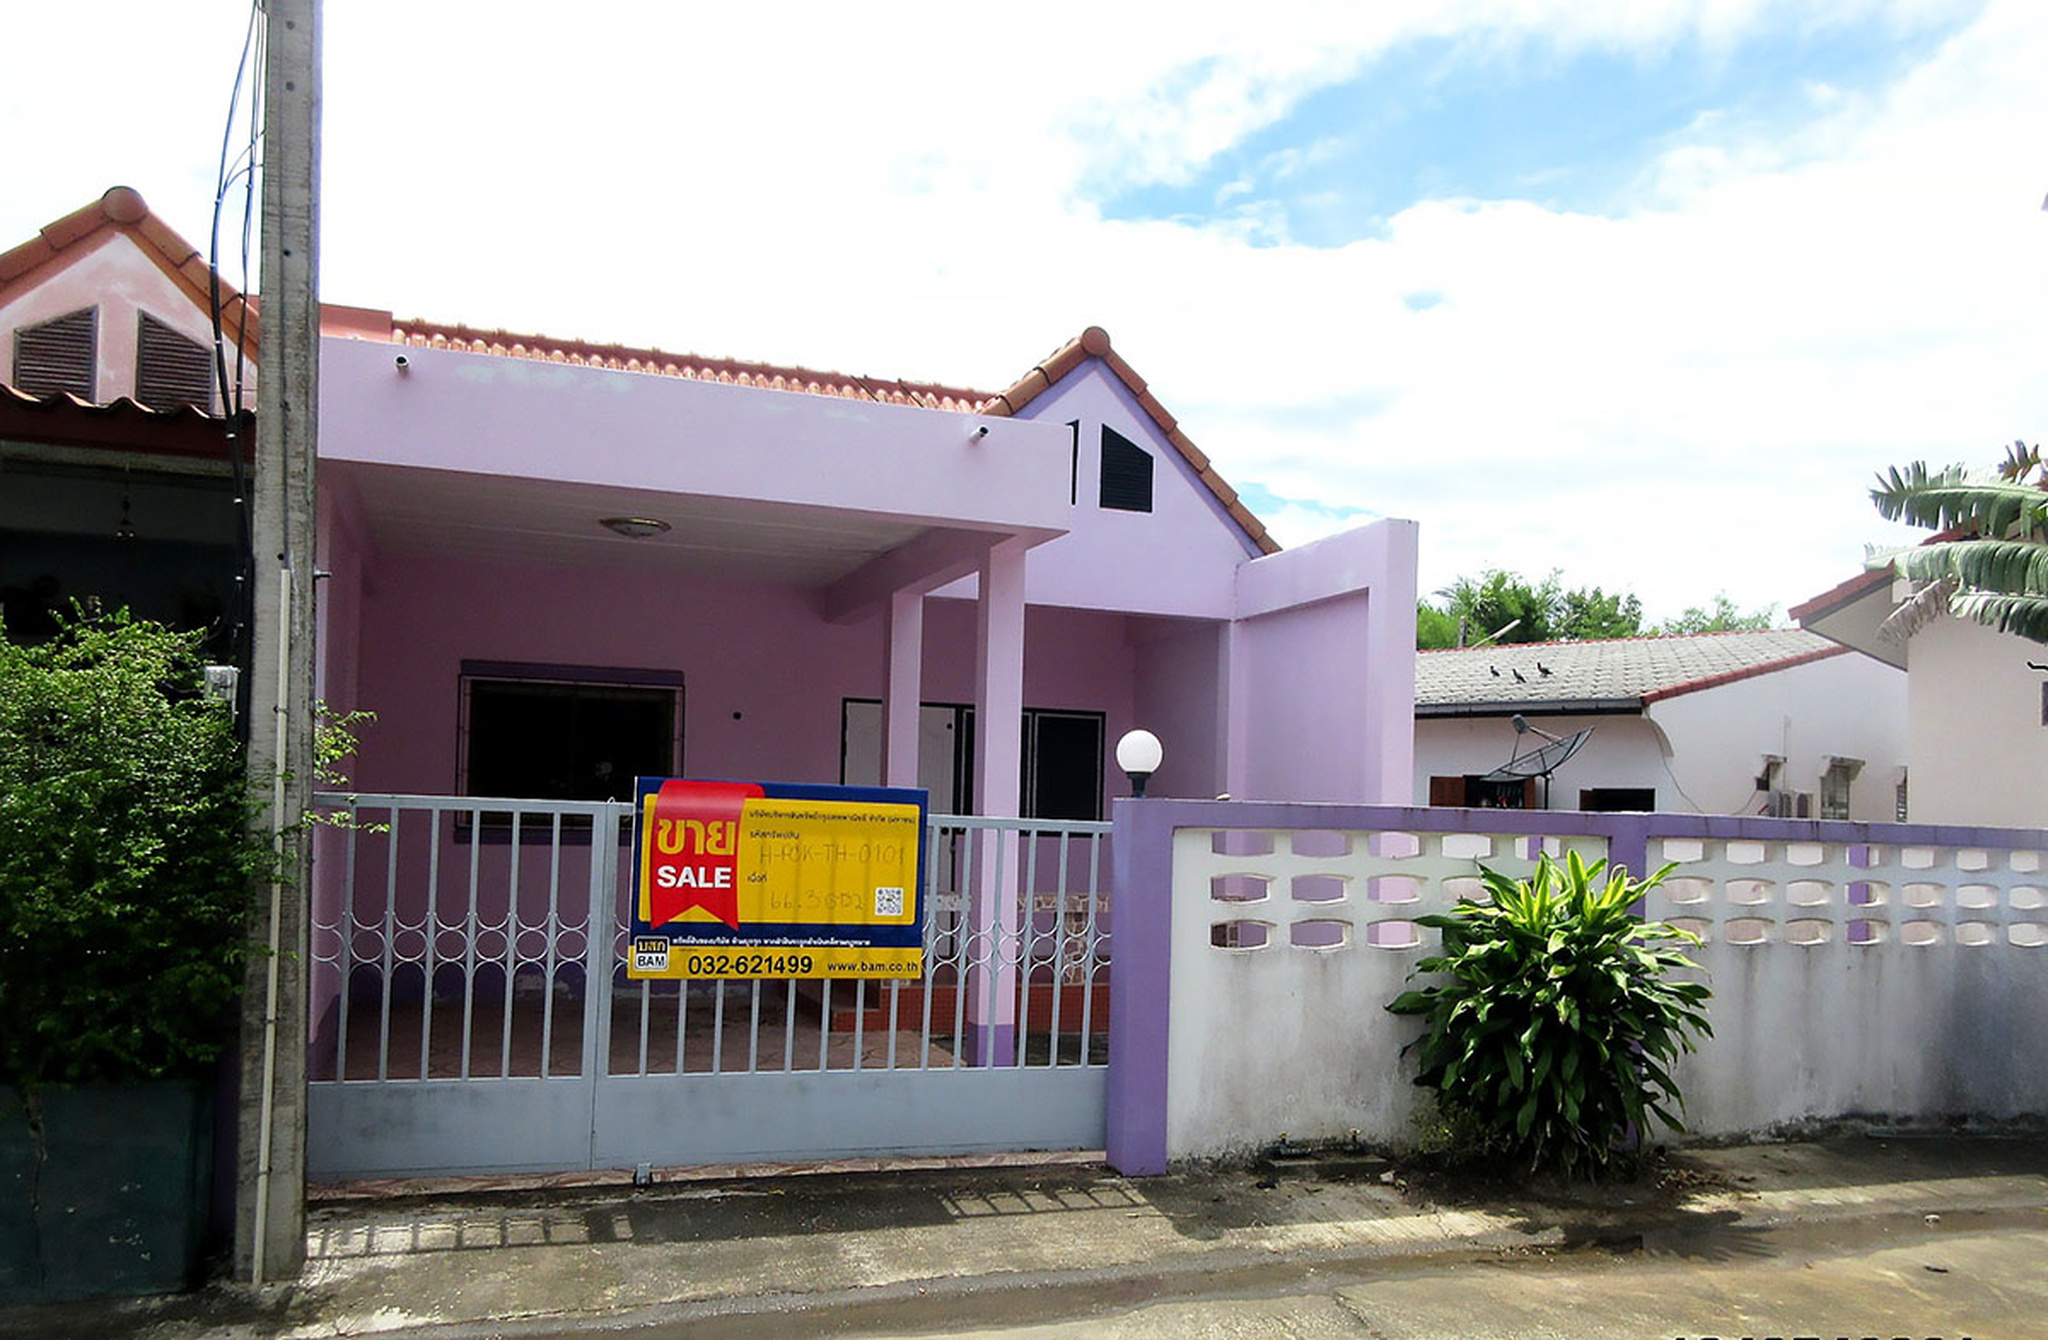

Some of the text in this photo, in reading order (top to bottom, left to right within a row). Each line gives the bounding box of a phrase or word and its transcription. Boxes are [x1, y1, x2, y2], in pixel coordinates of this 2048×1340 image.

[657, 819, 736, 855] ขาย
[657, 865, 732, 888] SALE
[637, 955, 665, 967] BAM
[688, 954, 813, 975] 032-621499
[827, 961, 919, 972] www.bam.co.th
